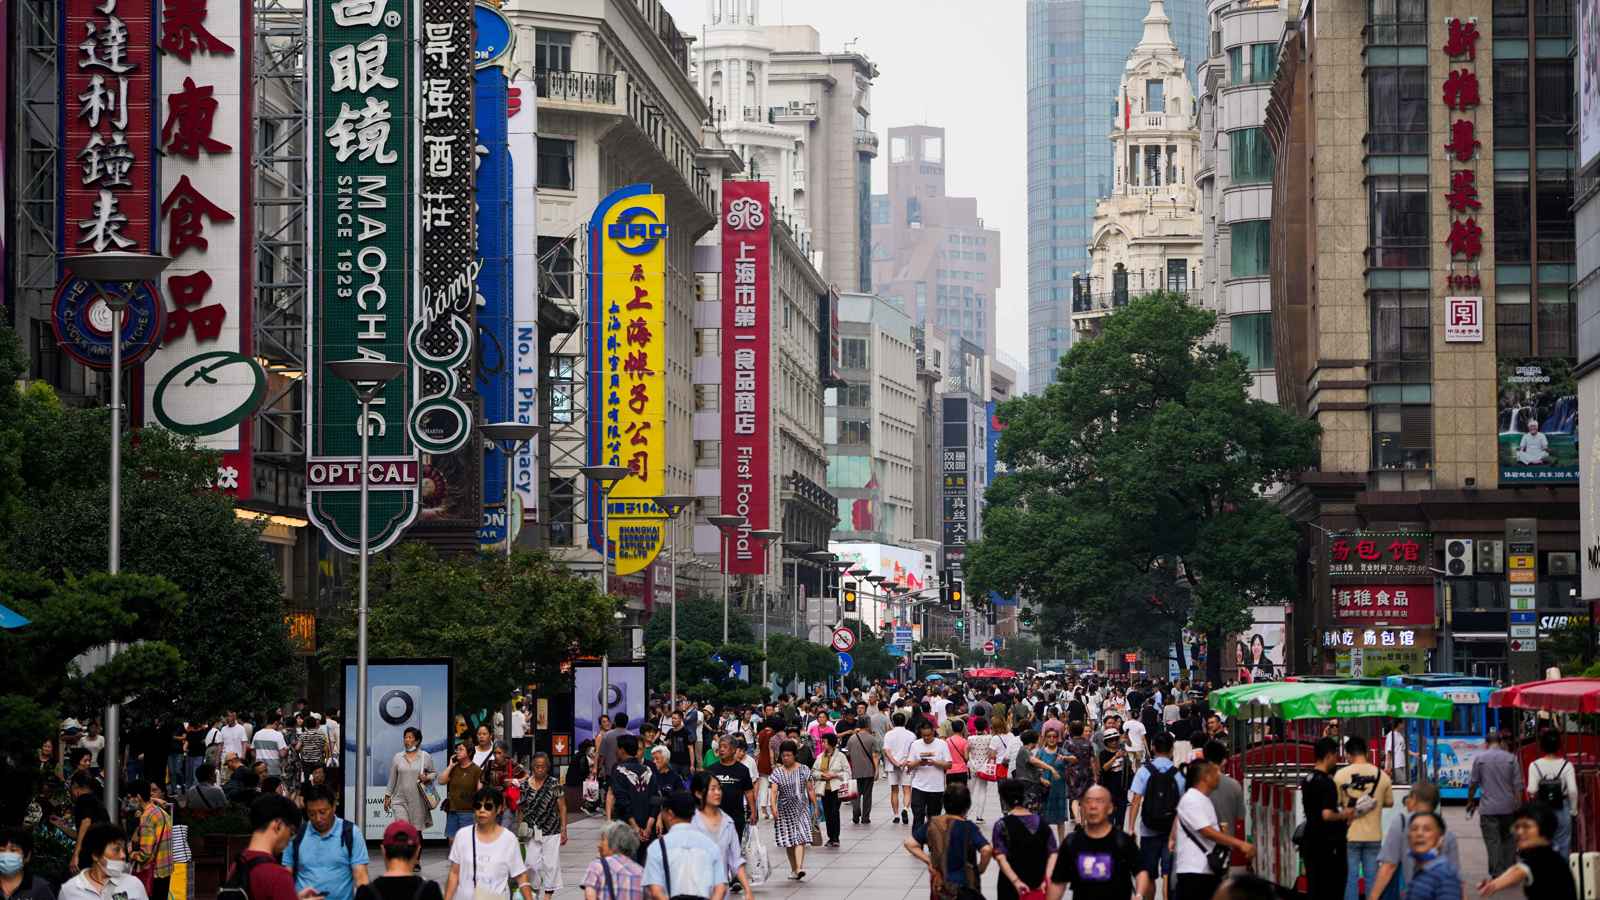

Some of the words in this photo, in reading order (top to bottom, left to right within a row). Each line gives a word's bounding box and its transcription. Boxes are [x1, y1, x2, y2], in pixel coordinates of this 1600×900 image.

[78, 0, 137, 252] 達利鐘表
[337, 175, 353, 238] SINCE
[337, 249, 353, 298] 1923
[517, 327, 533, 375] No.1
[734, 241, 757, 435] 上海市第一食品商店
[516, 387, 534, 494] Phamacy
[736, 446, 753, 480] First
[309, 464, 415, 484] OPTCAL
[952, 497, 967, 545] 真丝大王
[1338, 588, 1409, 606] 新雅食品
